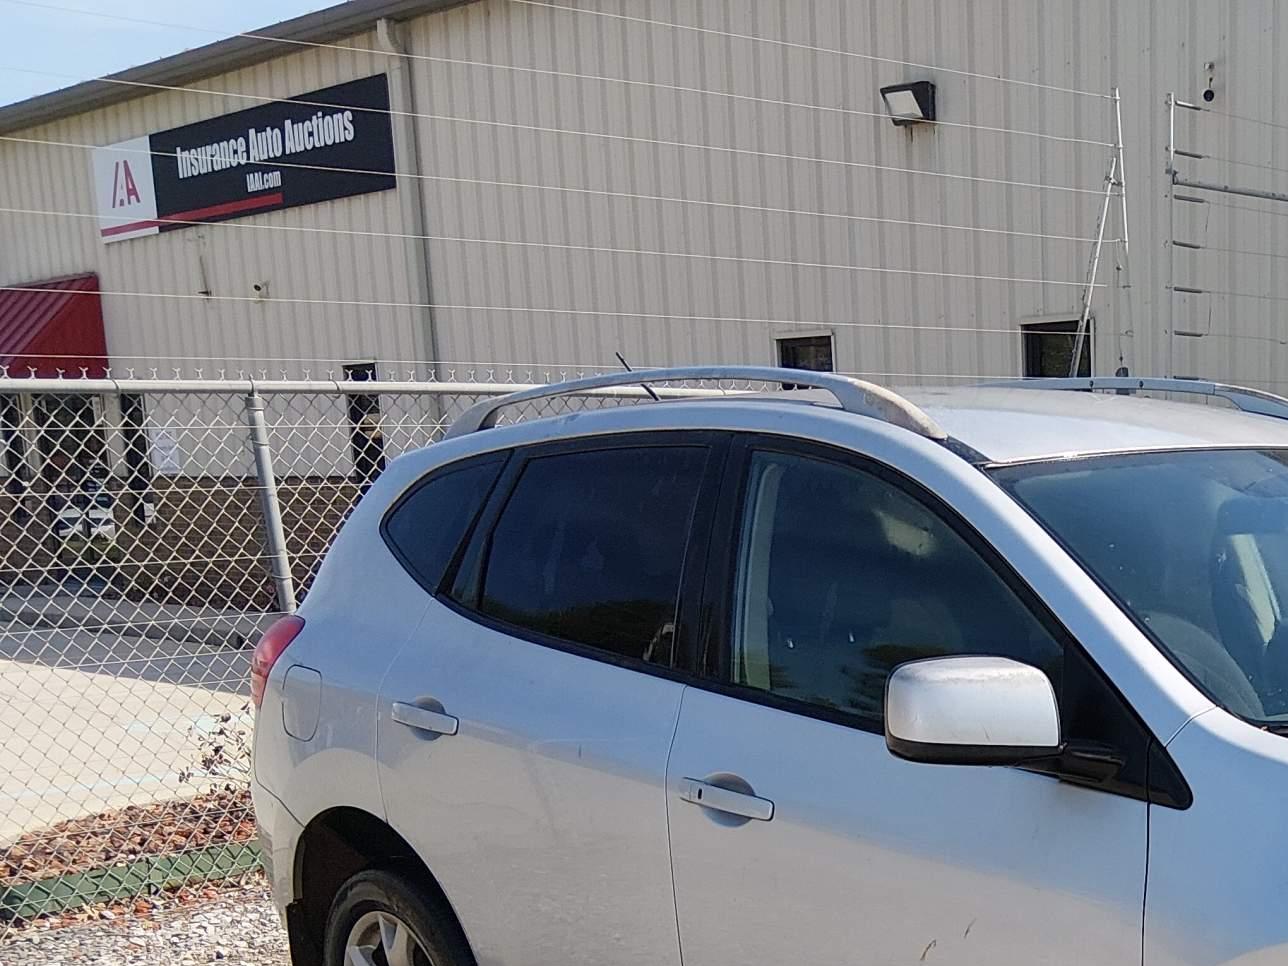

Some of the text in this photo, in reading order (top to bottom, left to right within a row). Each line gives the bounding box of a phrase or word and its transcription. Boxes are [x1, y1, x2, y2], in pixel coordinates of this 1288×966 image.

[176, 110, 354, 179] Insurance Auto Auctions
